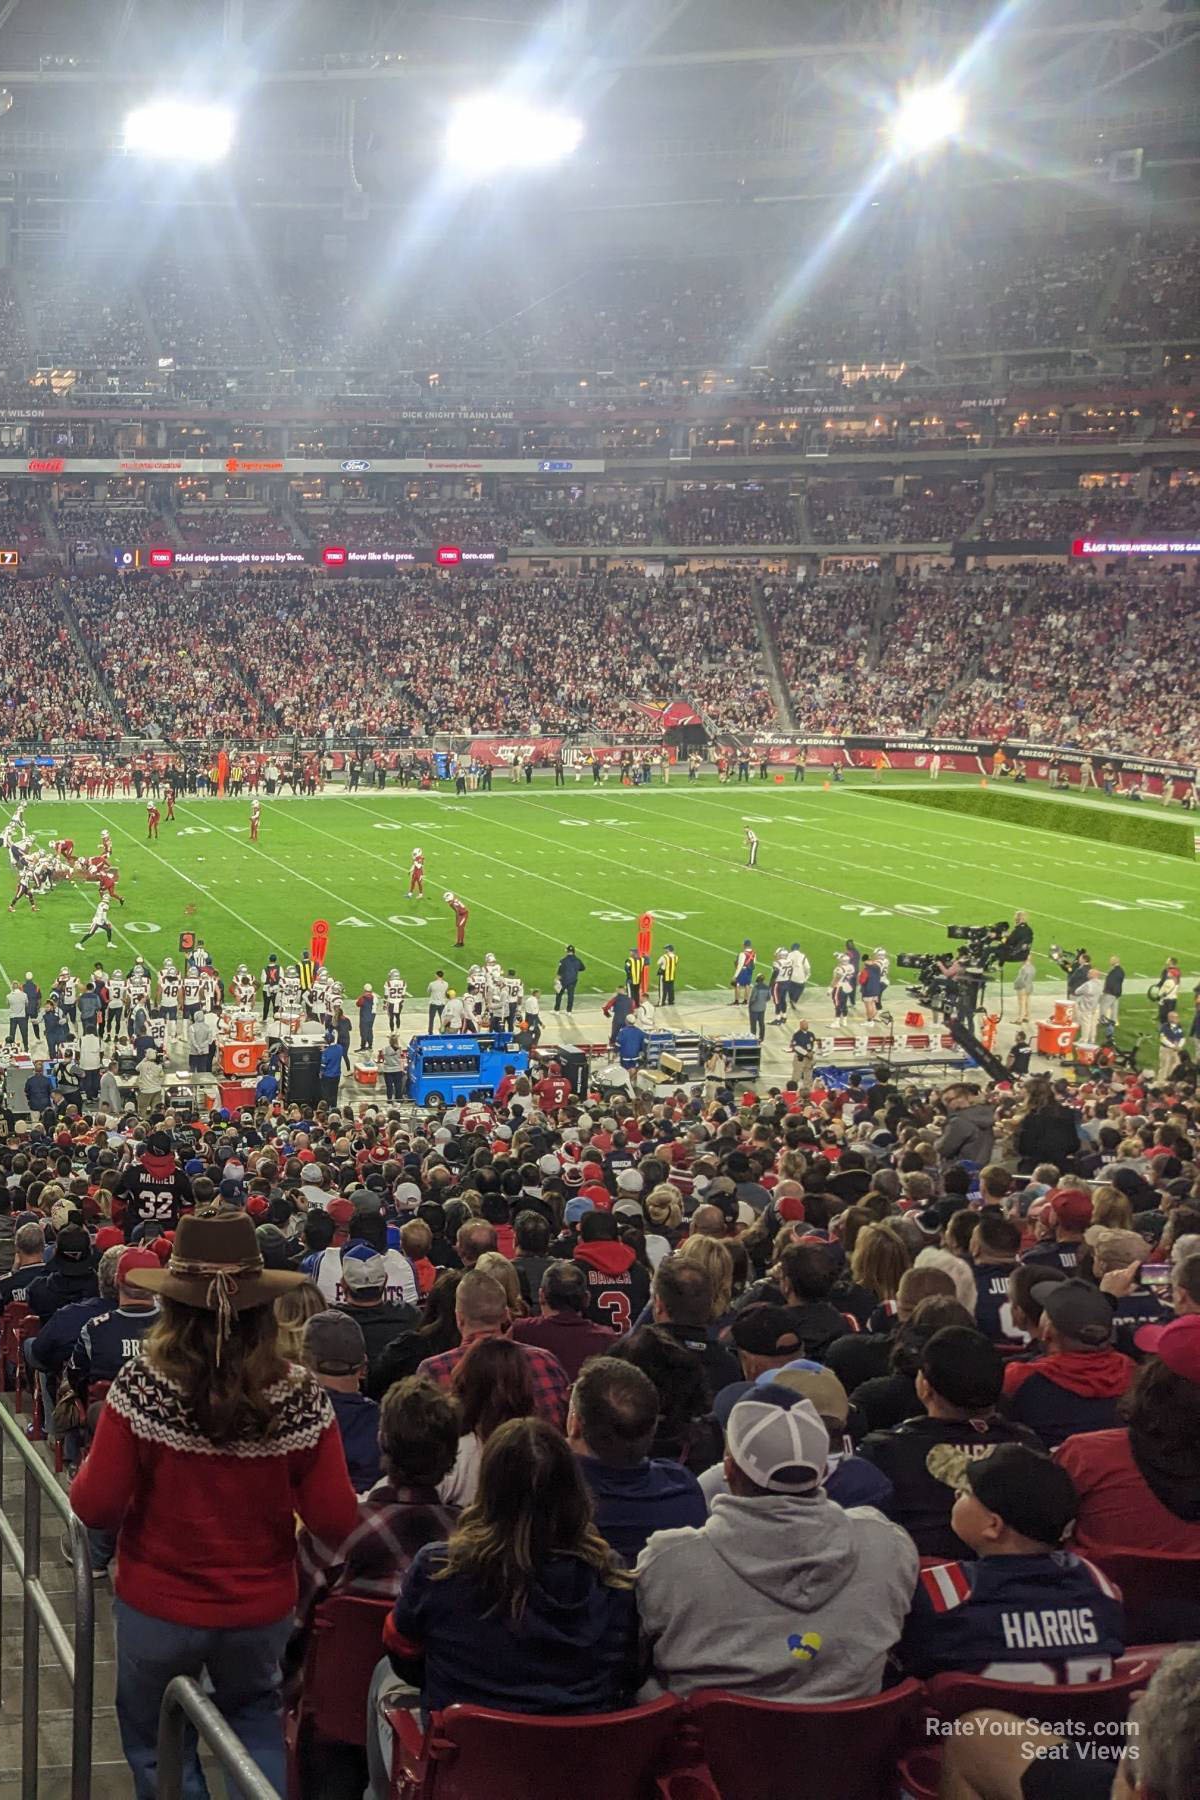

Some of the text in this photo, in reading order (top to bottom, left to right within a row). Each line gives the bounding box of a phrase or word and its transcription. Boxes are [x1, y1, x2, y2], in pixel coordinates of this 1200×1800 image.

[8, 409, 45, 417] WILSON
[783, 405, 856, 414] KURT WARNER
[4, 554, 12, 563] 7
[175, 554, 192, 562] Field
[194, 554, 219, 563] stripes
[220, 554, 250, 563] brought
[276, 554, 285, 563] by
[368, 552, 381, 560] like
[795, 738, 845, 746] CARDINALS
[182, 934, 193, 948] 3
[112, 988, 120, 998] 3
[163, 986, 178, 997] 48
[1057, 1033, 1072, 1047] G
[232, 1049, 250, 1069] G
[554, 1089, 564, 1104] 3
[138, 1189, 174, 1219] 32
[598, 1291, 631, 1335] 3
[1001, 1608, 1098, 1648] HARRIS
